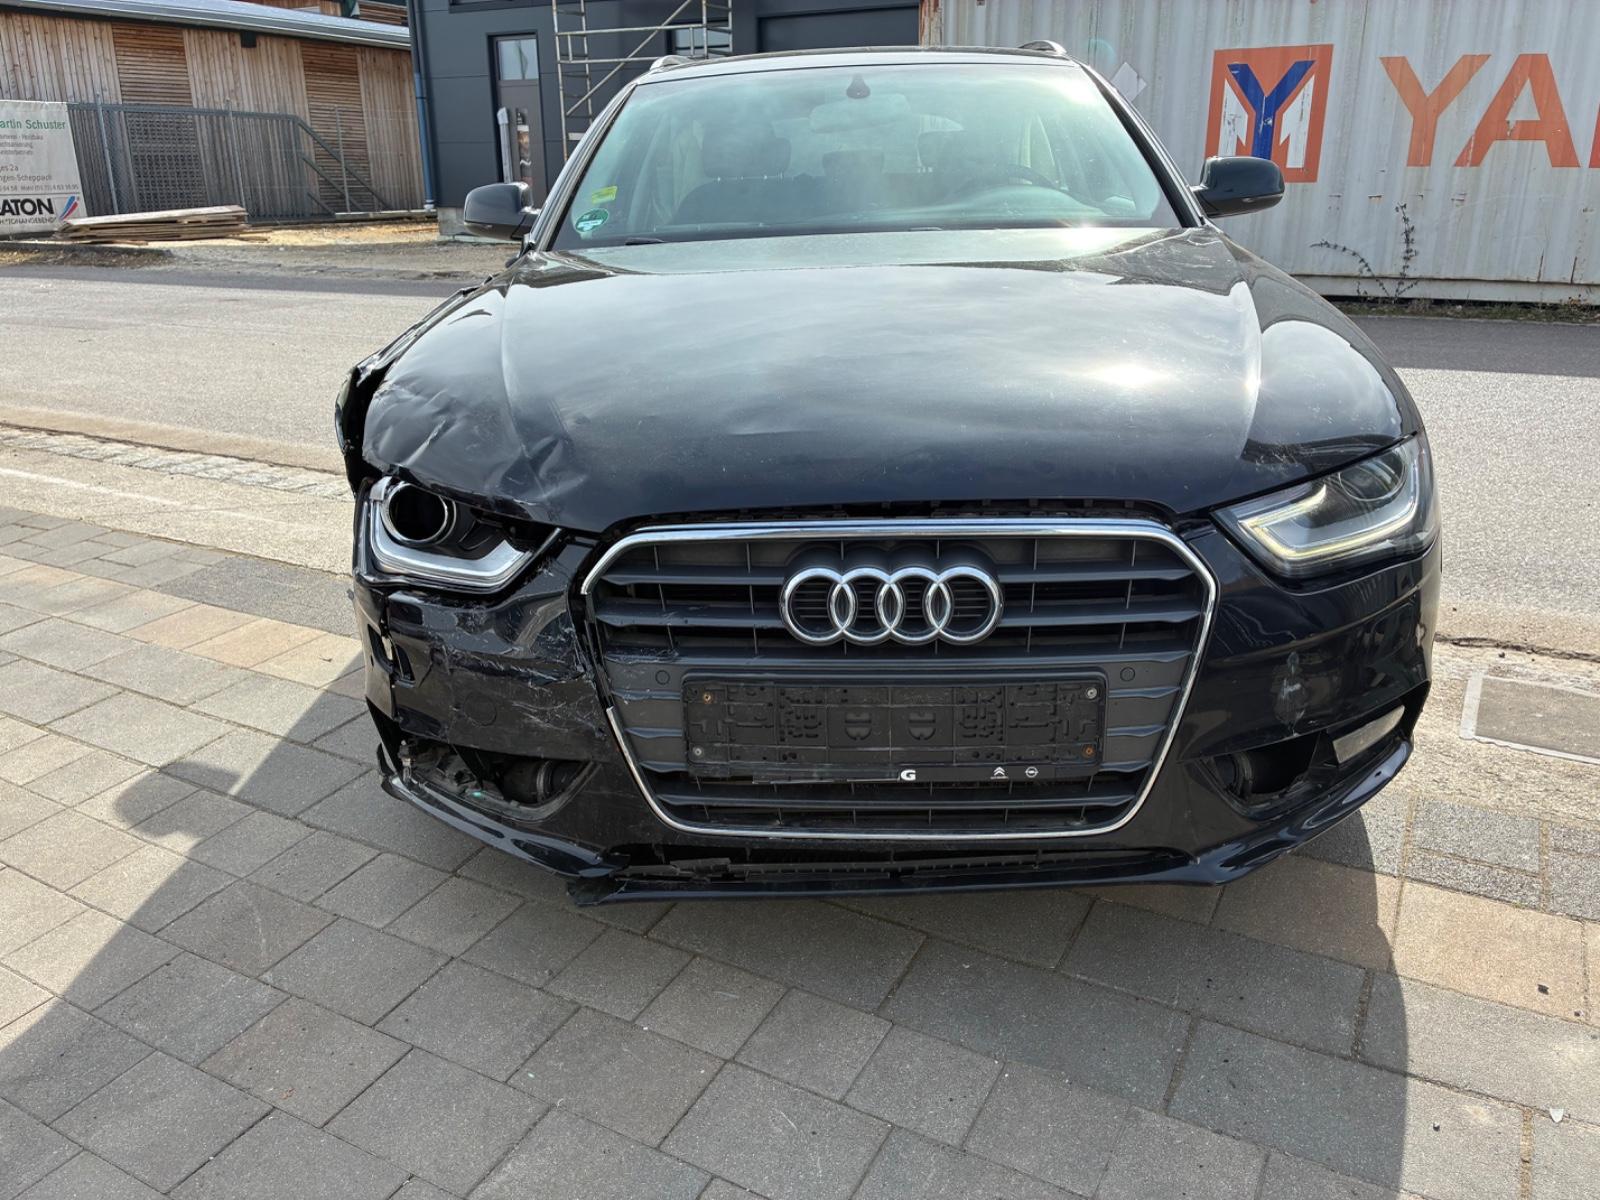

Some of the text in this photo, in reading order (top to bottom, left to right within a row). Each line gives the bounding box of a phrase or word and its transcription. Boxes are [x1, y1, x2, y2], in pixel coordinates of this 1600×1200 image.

[1379, 53, 1600, 168] YA
[25, 119, 66, 130] Schuster
[0, 198, 54, 215] ATON
